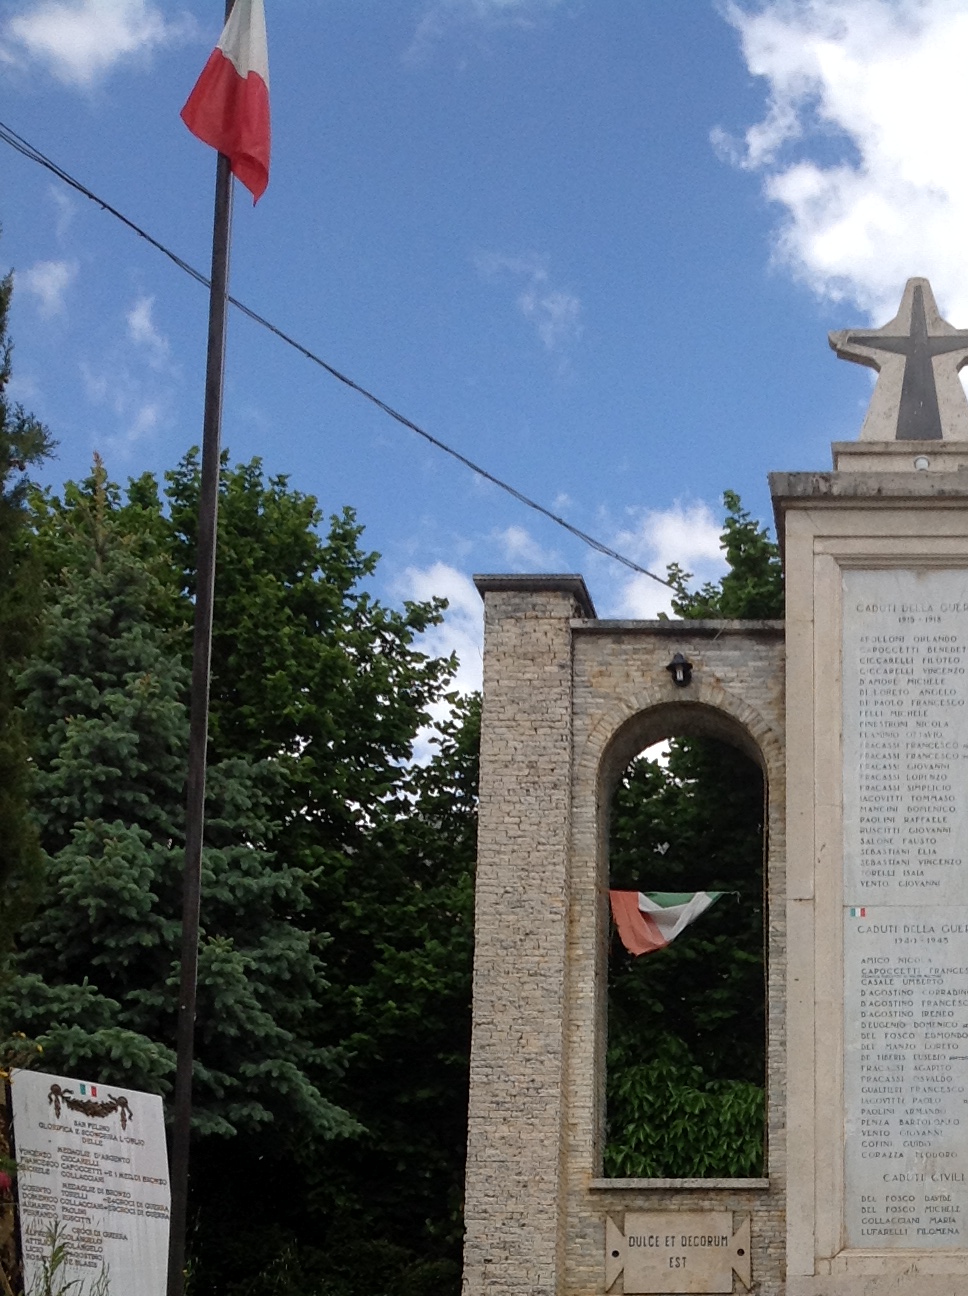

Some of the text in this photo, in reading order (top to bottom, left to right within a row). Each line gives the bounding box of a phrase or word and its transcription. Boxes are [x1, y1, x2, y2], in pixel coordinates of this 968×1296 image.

[856, 604, 896, 613] CADUTI
[902, 604, 933, 613] DELLA
[858, 925, 897, 934] CADUTI
[904, 925, 935, 933] DELLA
[883, 1173, 964, 1182] CADUTI CIVILI
[629, 1235, 728, 1247] DULCE ET DECORUM
[670, 1257, 686, 1267] EST
